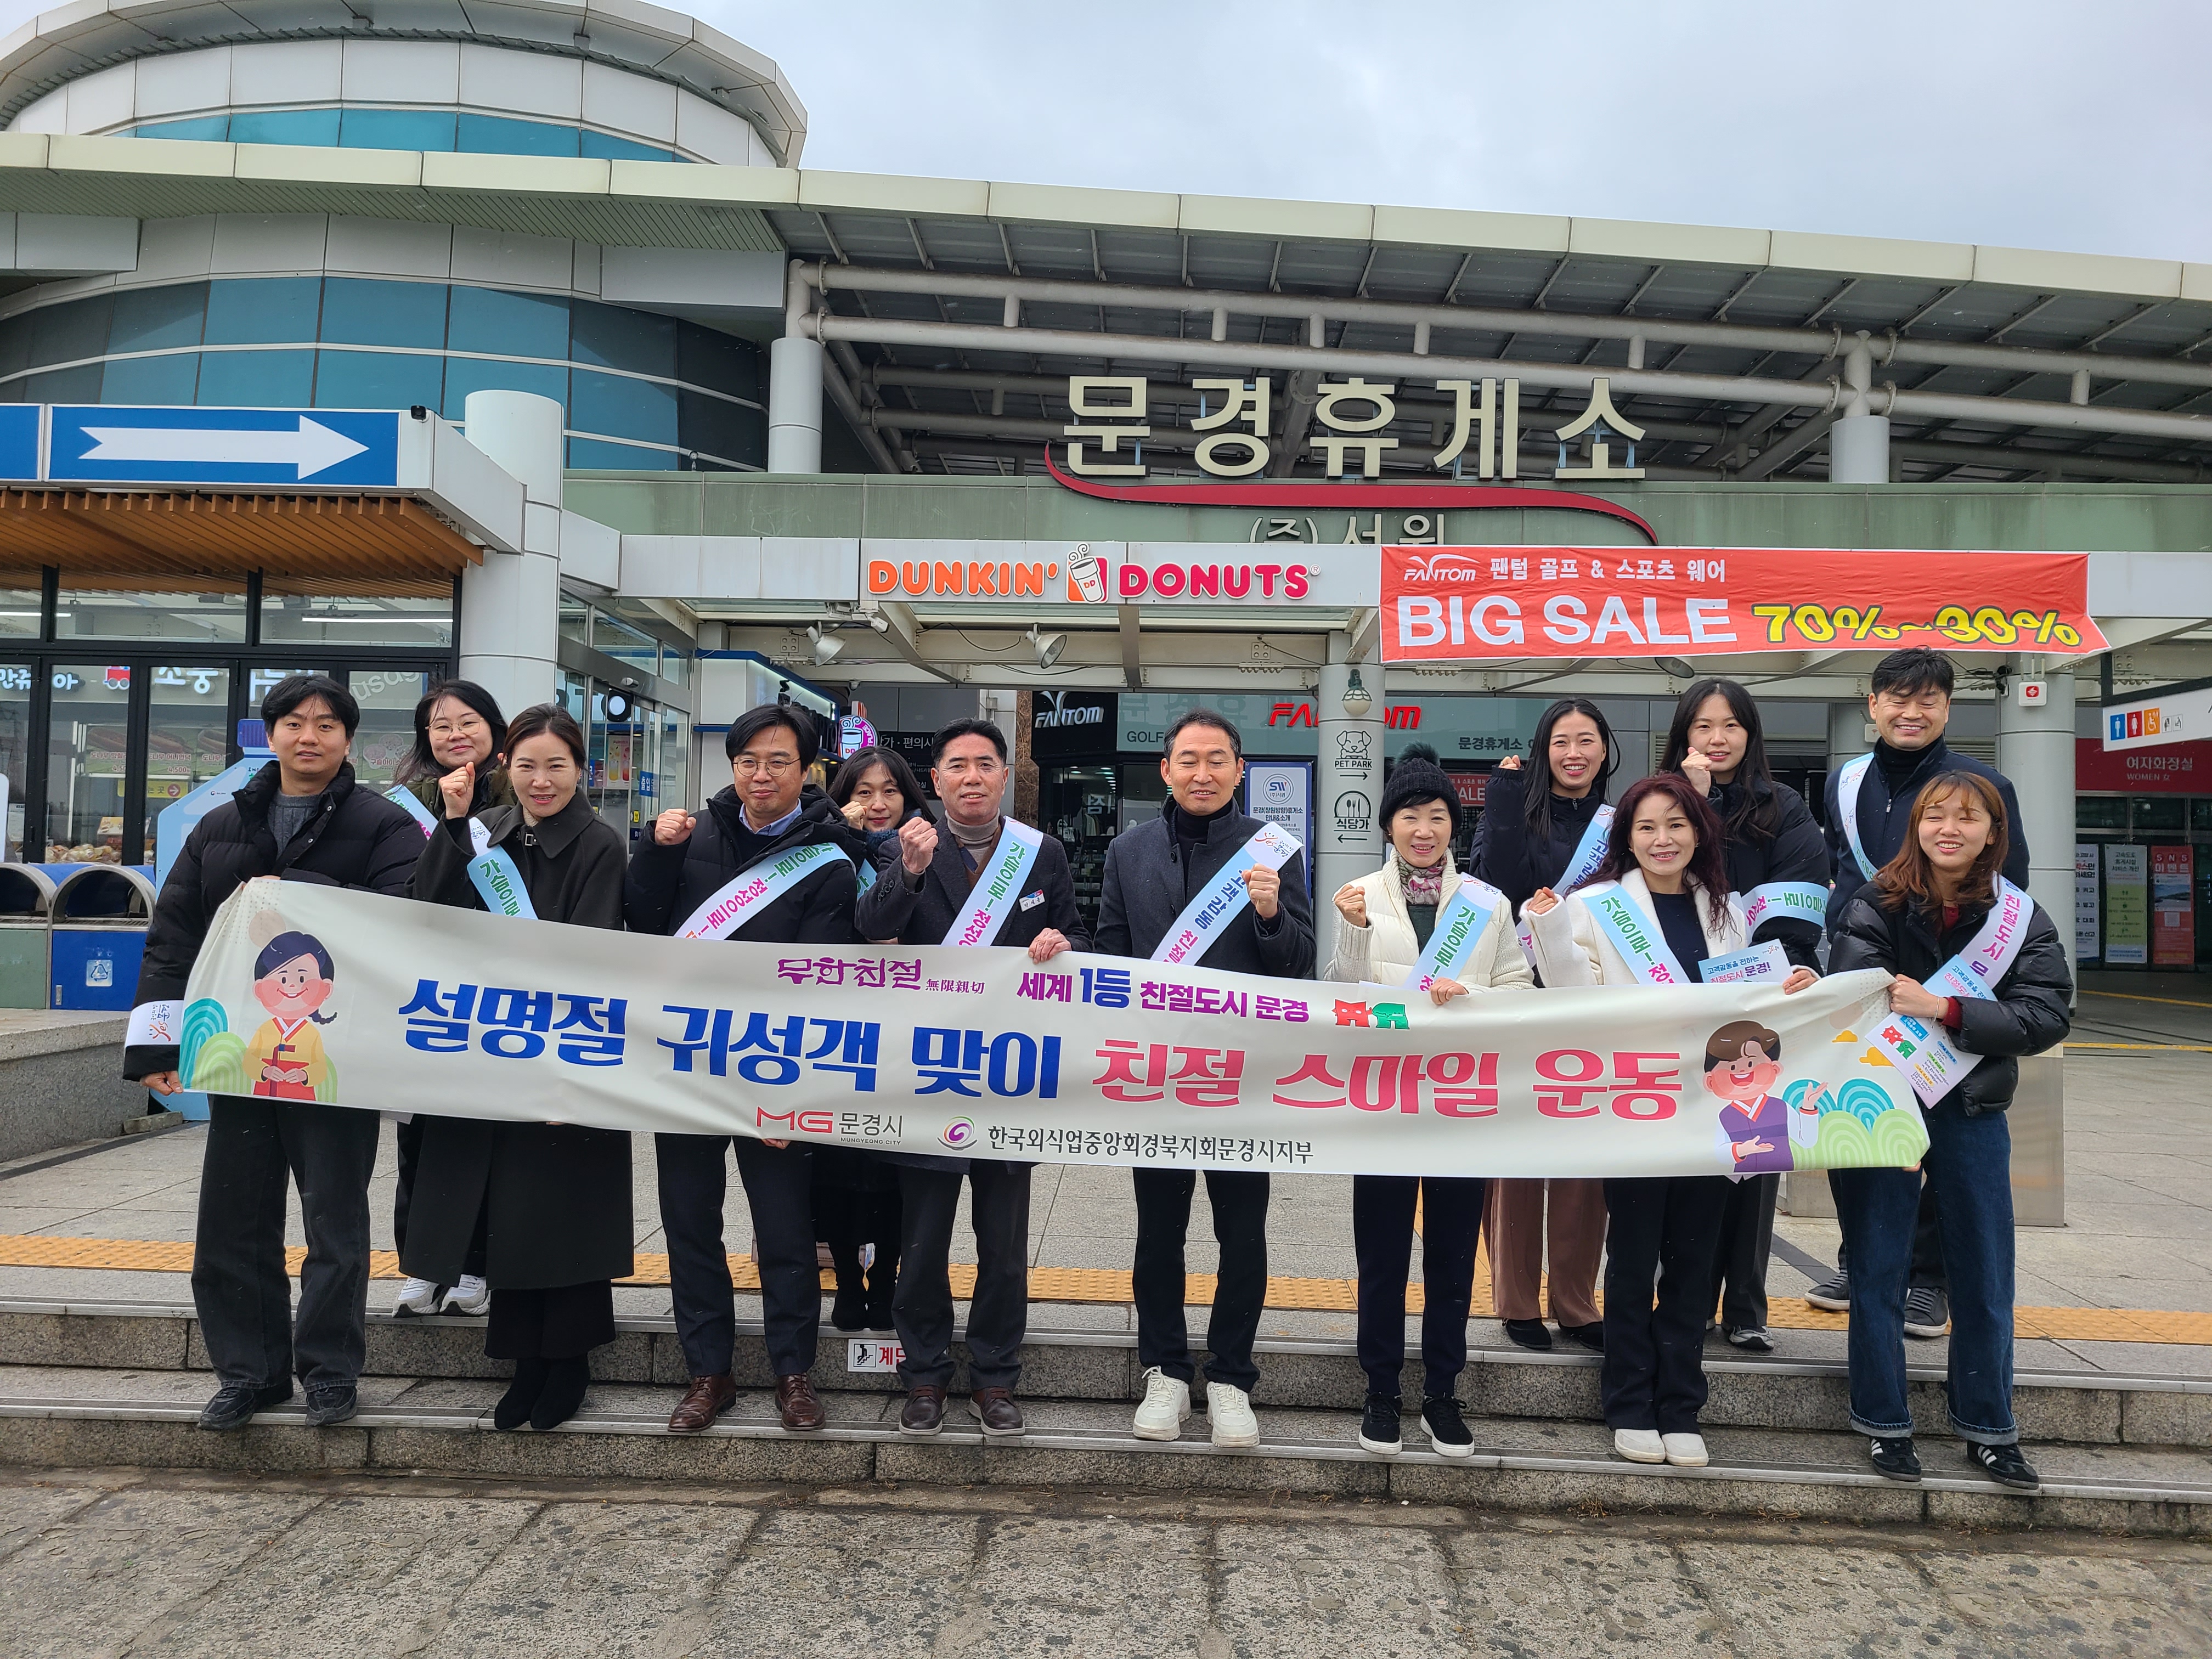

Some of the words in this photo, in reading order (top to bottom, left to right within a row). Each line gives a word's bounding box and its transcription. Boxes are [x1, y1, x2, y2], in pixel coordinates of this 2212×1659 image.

[1064, 376, 1646, 481] 문경휴게소
[868, 560, 1059, 597] DUNKIN'
[1118, 563, 1310, 600] DONUTS
[1404, 562, 1477, 582] FANTOM
[1491, 557, 1528, 580] 팬텀
[1539, 558, 1579, 580] 골프
[1591, 560, 1605, 579] &
[1616, 559, 1675, 580] 스포츠
[1687, 559, 1726, 583] 웨어
[1398, 595, 1525, 647] BIG
[1543, 595, 1737, 644] SALE
[1035, 699, 1104, 729] FANTOM
[1127, 731, 1164, 743] GOLF
[1458, 737, 1523, 751] 문경휴게소
[1334, 760, 1350, 768] PET
[1351, 760, 1372, 768] PARK
[2126, 756, 2193, 771] 여자화장실
[1458, 787, 1485, 801] ALE
[1336, 819, 1369, 830] 식당가
[777, 957, 922, 991] 무한친절
[925, 977, 985, 995] 無限親切
[1017, 971, 1073, 1003] 세계
[1079, 967, 1132, 1008] 1등
[1139, 980, 1249, 1018] 친절도시
[1255, 995, 1310, 1023] 문경
[398, 978, 628, 1068] 설명절
[657, 1004, 882, 1093] 귀성객
[911, 1026, 1062, 1099] 맞이
[1092, 1039, 1246, 1108] 친절
[1273, 1051, 1500, 1119] 스마일
[1532, 1048, 1683, 1121] 운동
[757, 1105, 834, 1134] MG
[838, 1111, 904, 1138] 문경시
[840, 1137, 883, 1146] MUNGYEONG
[988, 1125, 1315, 1165] 한국외식업중앙회경북지회문경시지부
